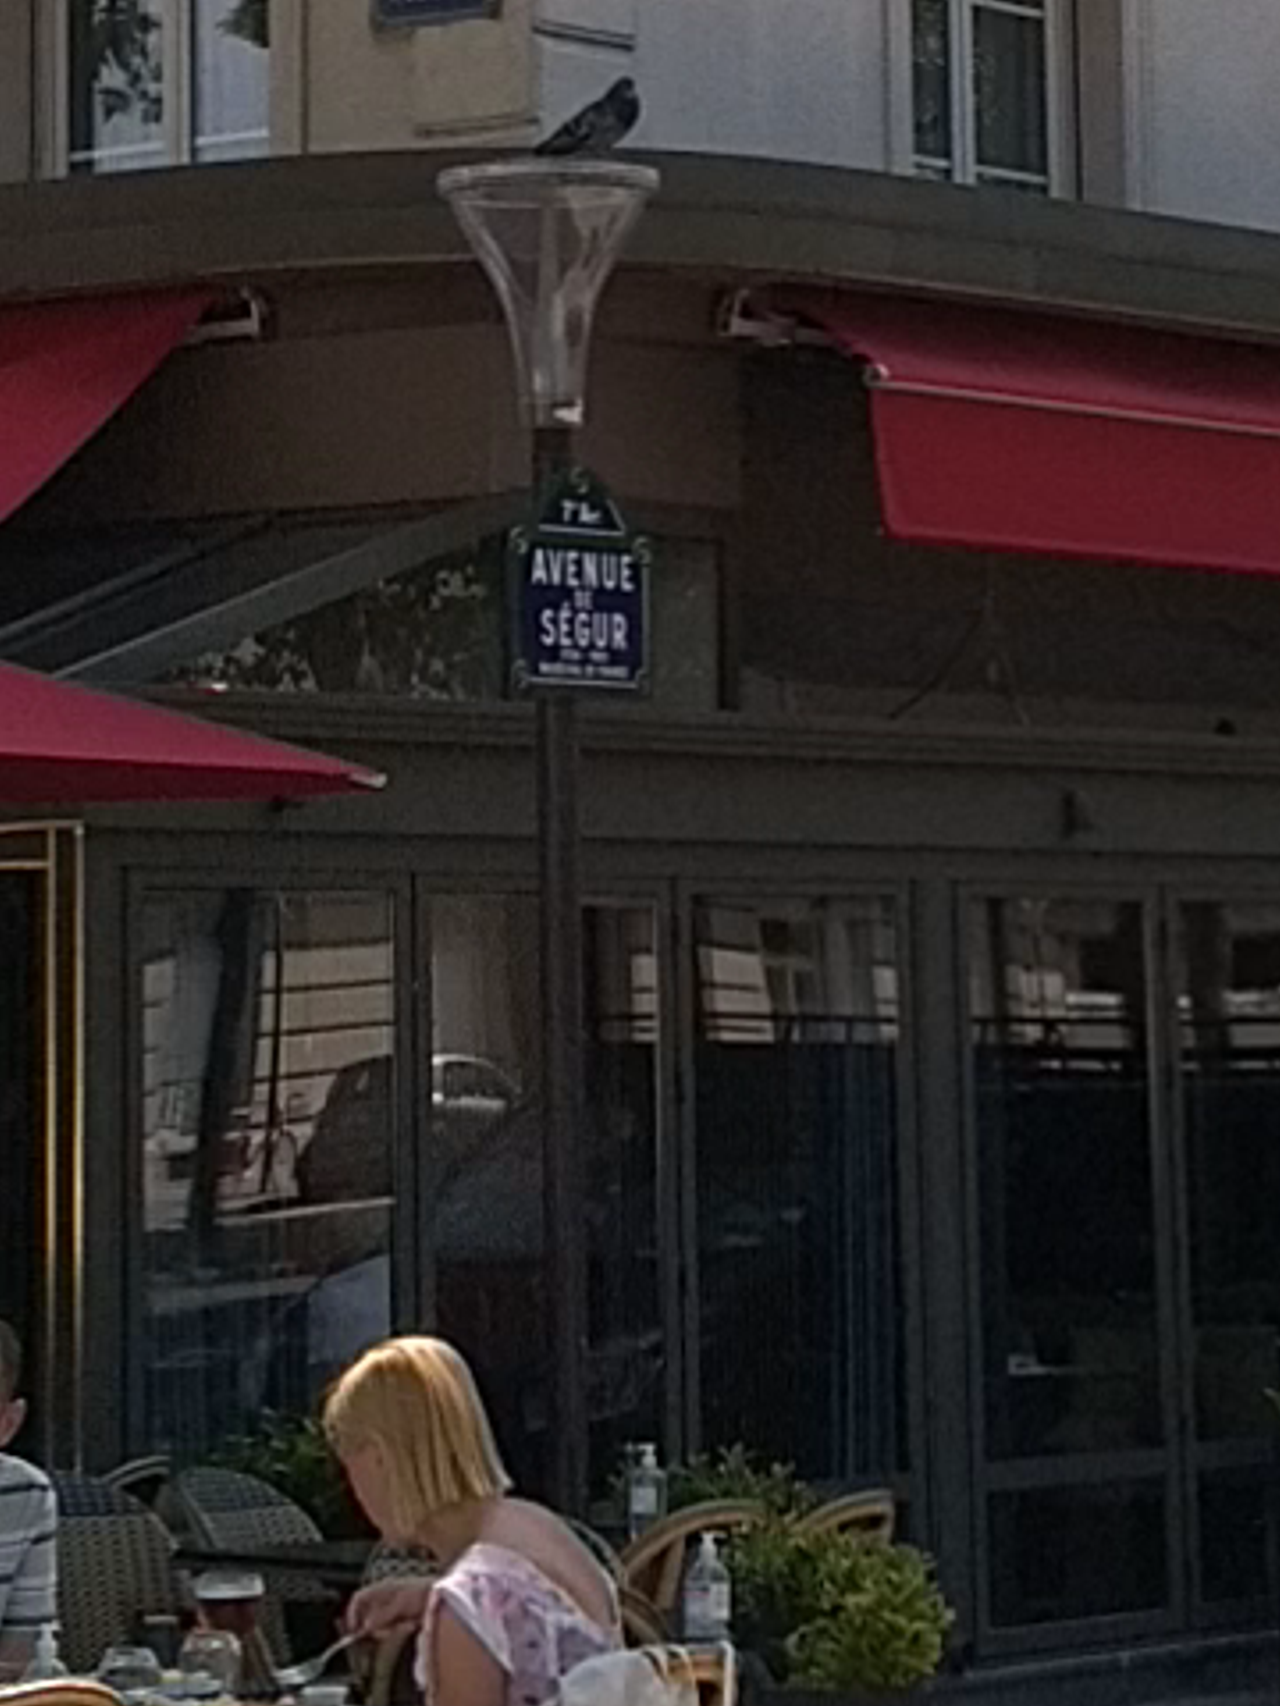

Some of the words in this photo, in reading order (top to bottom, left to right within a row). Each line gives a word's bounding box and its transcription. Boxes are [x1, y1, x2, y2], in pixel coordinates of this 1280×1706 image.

[531, 547, 636, 592] AVENUE
[574, 590, 594, 610] DE
[540, 600, 629, 650] SÉGUR
